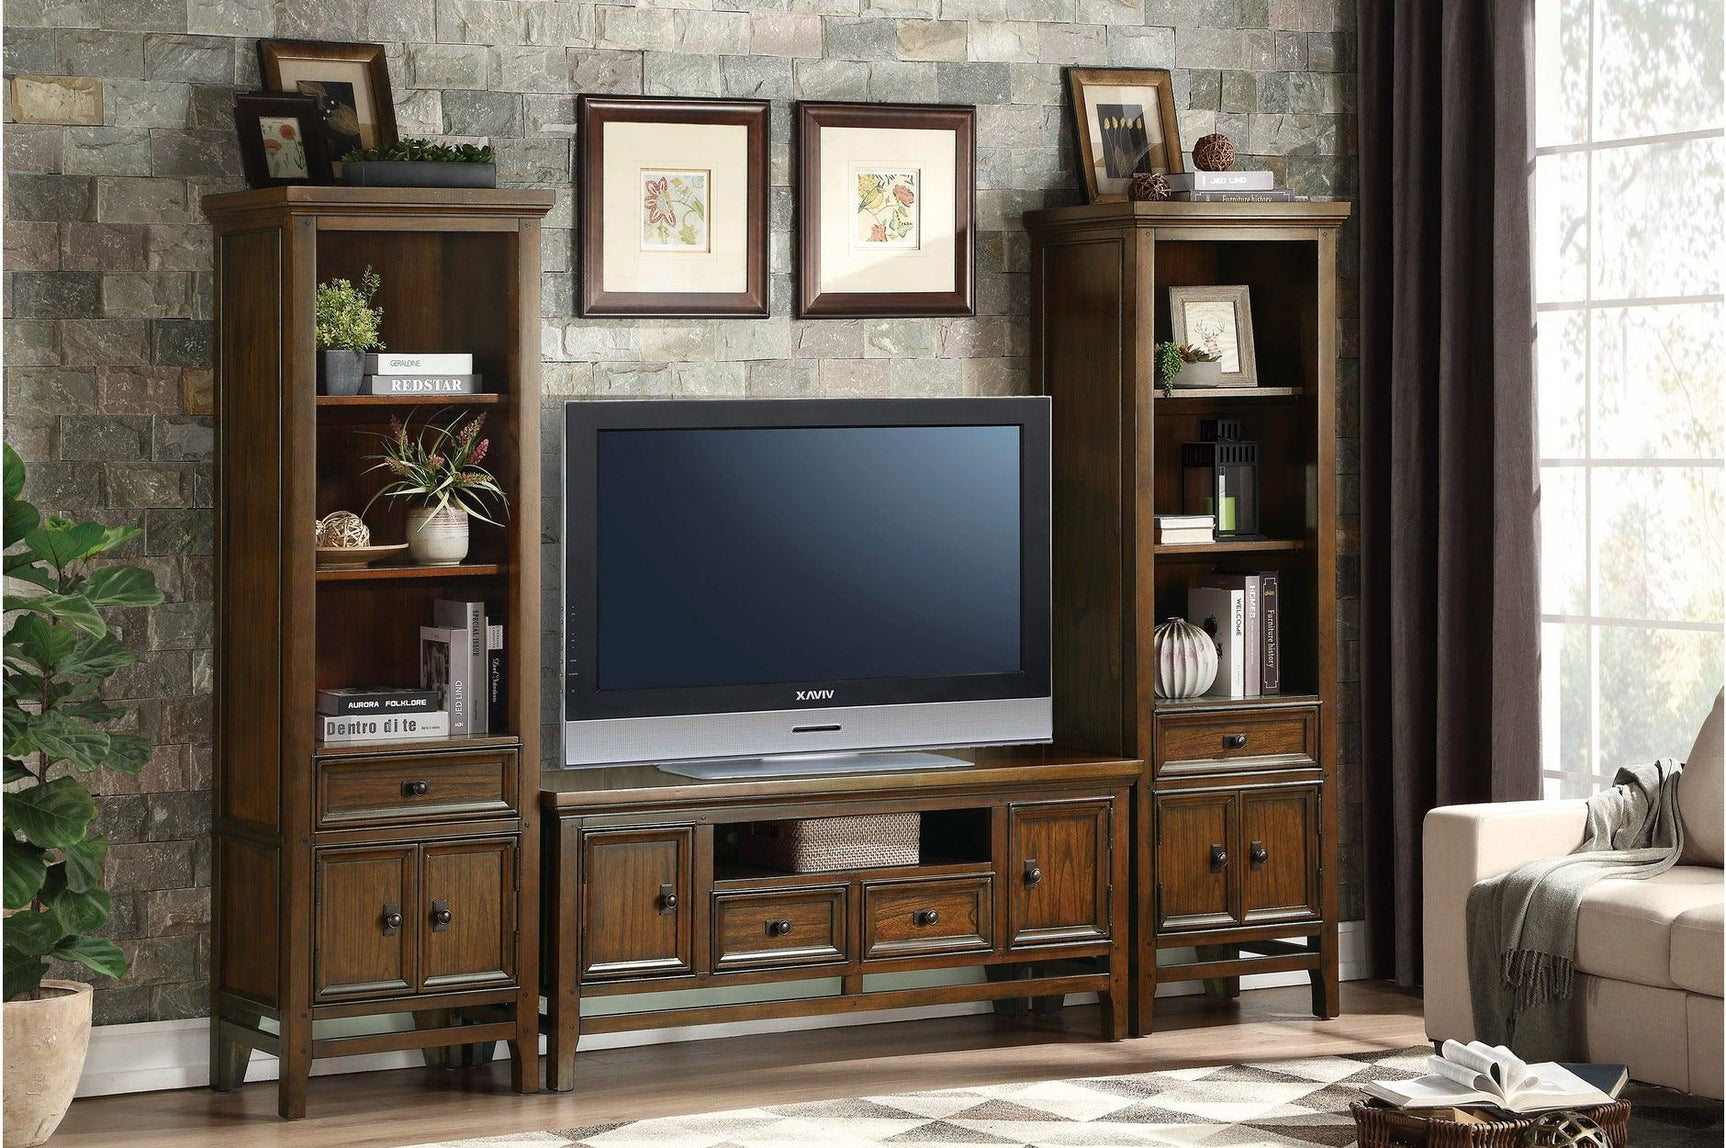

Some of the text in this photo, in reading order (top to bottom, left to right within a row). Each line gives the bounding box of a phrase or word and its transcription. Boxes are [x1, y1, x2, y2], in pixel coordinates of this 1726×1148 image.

[1222, 194, 1250, 203] Furniture
[389, 359, 421, 368] GERALDINE
[391, 379, 462, 392] REDSTAR
[472, 610, 480, 657] SPECIAL ISSUE
[1265, 609, 1276, 668] Furniture history
[455, 680, 463, 700] LIND
[348, 699, 427, 709] AURORA FOLKLORE
[455, 701, 463, 716] JED
[326, 720, 377, 736] Dentro
[403, 718, 417, 732] te
